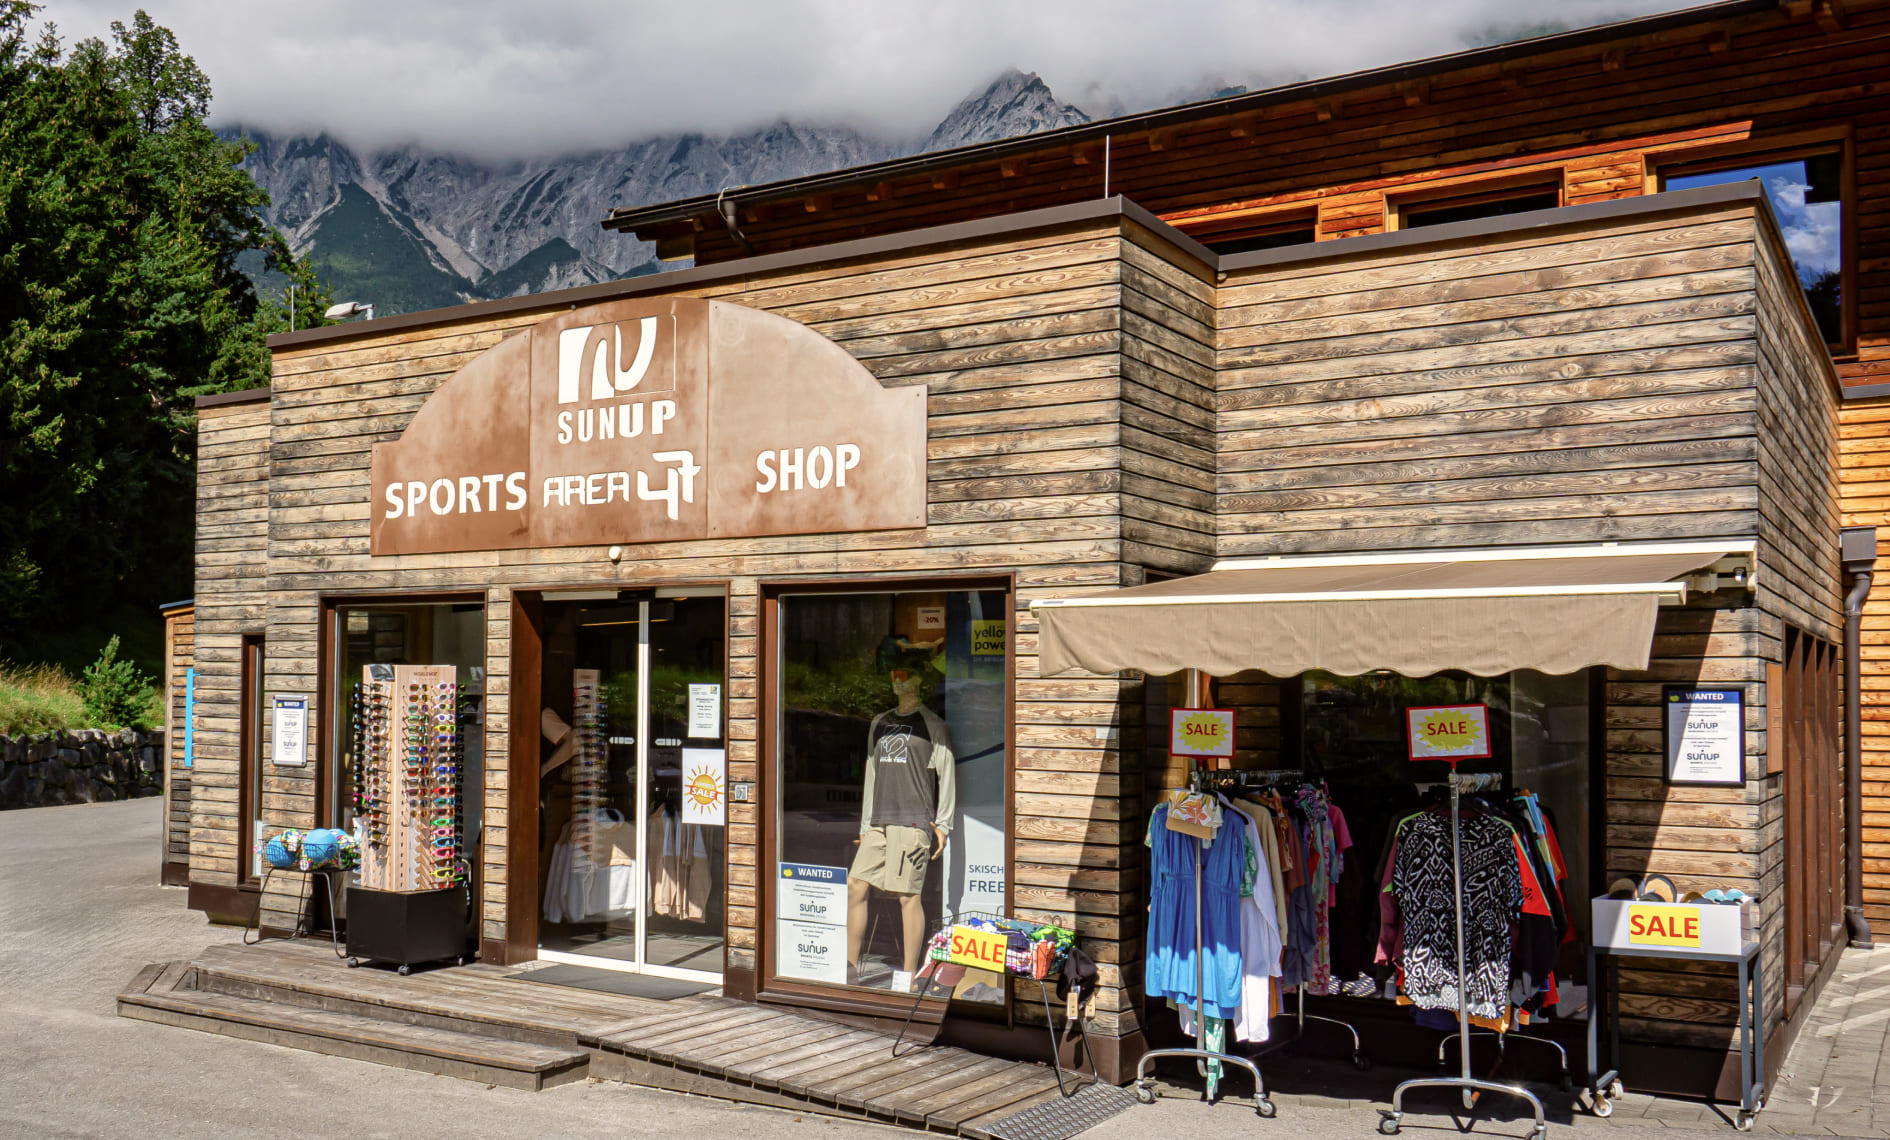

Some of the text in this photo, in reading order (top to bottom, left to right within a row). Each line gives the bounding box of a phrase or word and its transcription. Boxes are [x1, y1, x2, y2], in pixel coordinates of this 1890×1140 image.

[558, 400, 676, 444] SUNUP
[756, 443, 861, 494] SHOP
[385, 471, 527, 519] SPORTS
[543, 471, 630, 508] AREA
[974, 625, 1005, 640] yello
[1685, 692, 1724, 701] WANTED
[1186, 722, 1218, 736] SALE
[1427, 721, 1468, 736] SALE
[691, 787, 715, 800] SALE
[798, 867, 833, 879] WANTED
[1630, 914, 1699, 939] SALE
[951, 935, 1005, 964] SALE
